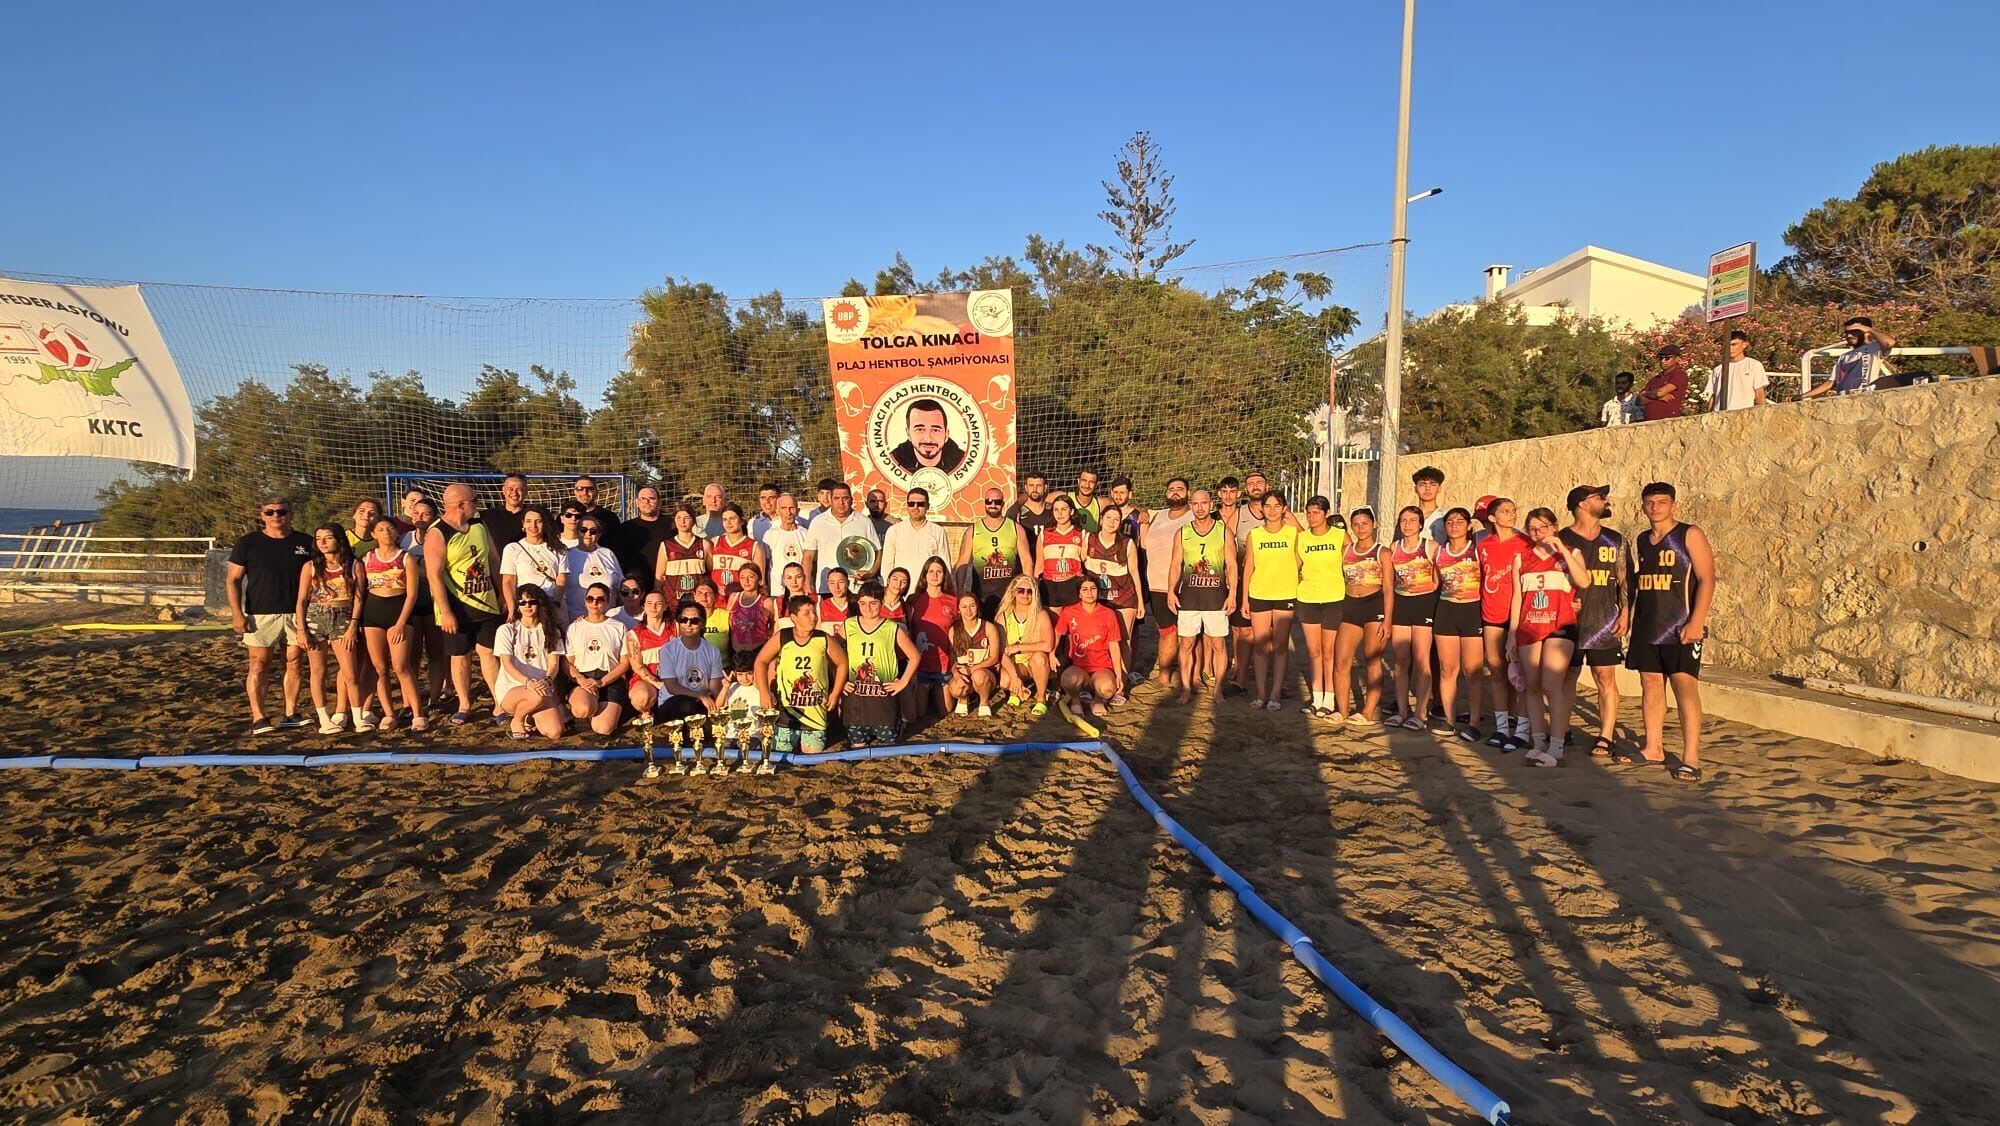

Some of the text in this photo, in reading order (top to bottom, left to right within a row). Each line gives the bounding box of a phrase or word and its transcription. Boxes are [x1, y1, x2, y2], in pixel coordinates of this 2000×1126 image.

[837, 311, 854, 321] UBP
[860, 336, 917, 349] TOLGA
[922, 333, 979, 346] KINACI
[4, 356, 32, 365] 1991
[837, 353, 1009, 371] PLAJ HENTBOL ŞAMPİYONASI
[883, 388, 909, 410] PLAJ
[910, 384, 963, 406] HENTBOL
[88, 418, 143, 438] KKTC
[873, 408, 887, 448] KINACI
[880, 449, 908, 481] TOLGA
[991, 536, 999, 547] 9
[1199, 543, 1206, 555] 7
[1058, 545, 1066, 557] 7
[1598, 546, 1617, 563] 80
[1658, 550, 1676, 567] 10
[719, 556, 734, 569] 97
[1099, 562, 1107, 574] 6
[1536, 574, 1545, 589] 3
[860, 641, 874, 657] 11
[794, 656, 812, 670] 22
[967, 650, 975, 664] 9
